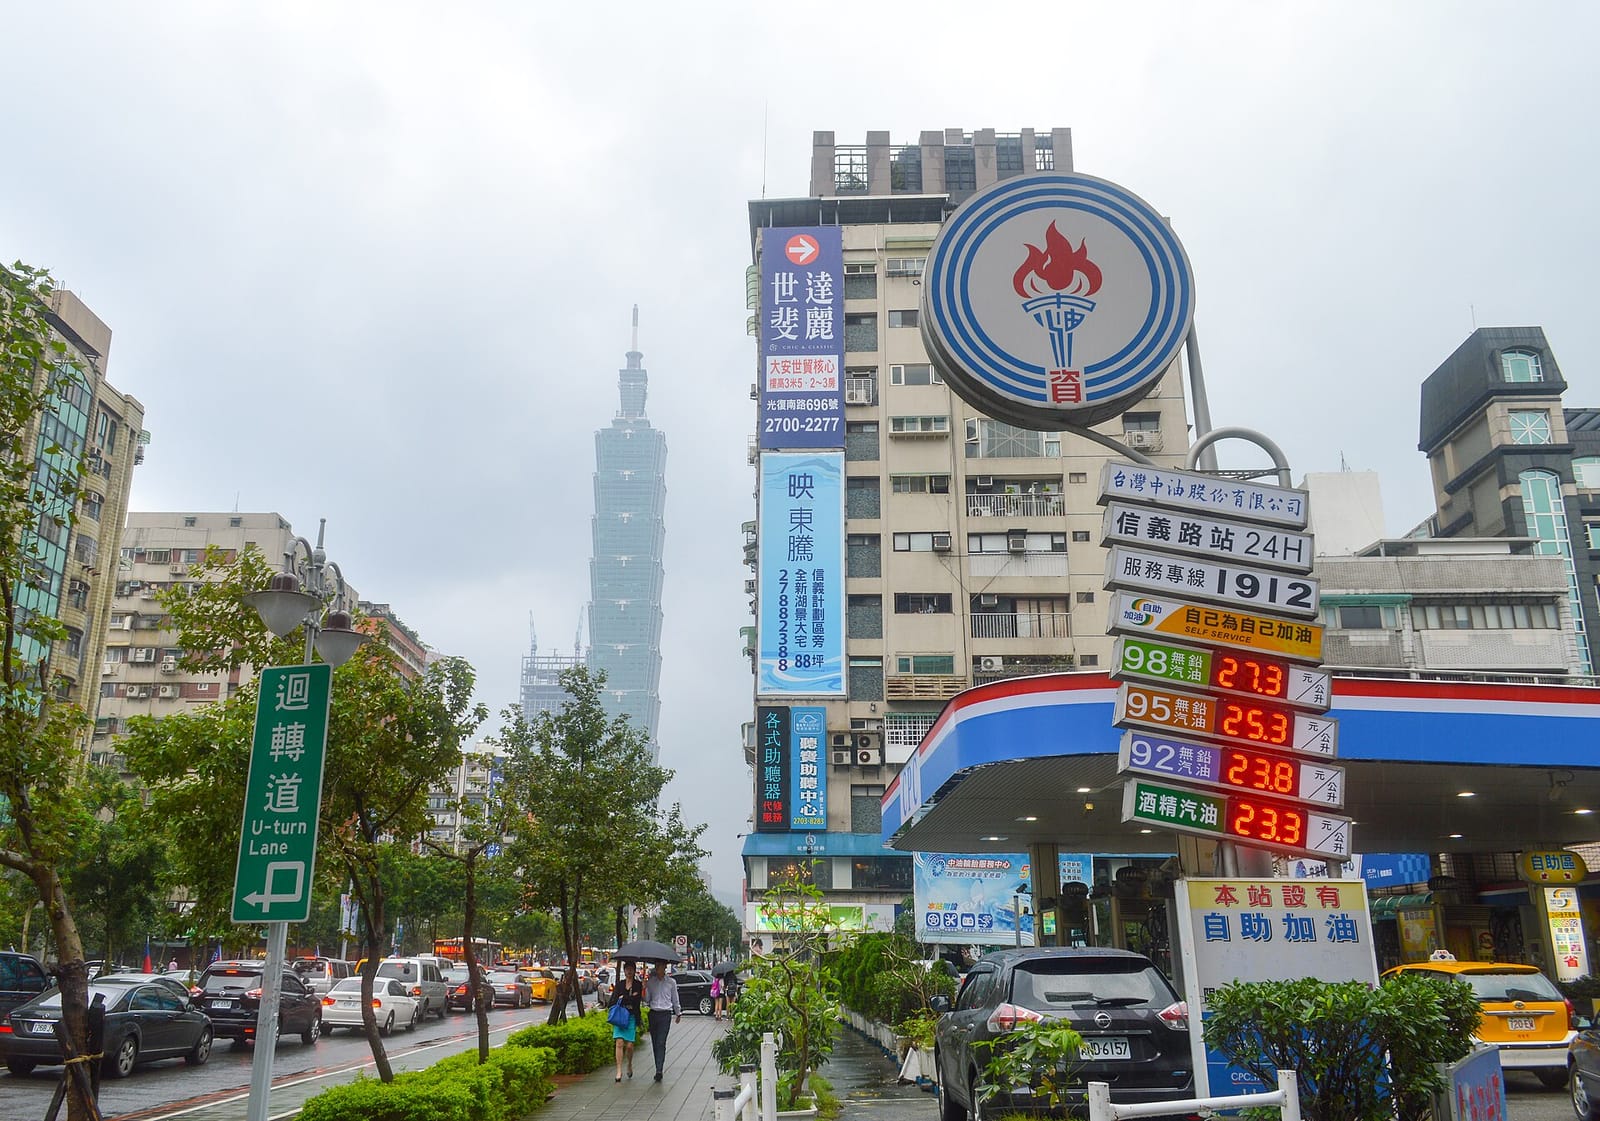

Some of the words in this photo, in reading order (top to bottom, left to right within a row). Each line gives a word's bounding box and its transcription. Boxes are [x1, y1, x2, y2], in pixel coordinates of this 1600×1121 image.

[770, 359, 835, 374] 大安世貿核心
[1050, 370, 1081, 404] 資
[766, 398, 839, 411] 光復南路696號
[765, 417, 840, 433] 2700-2277
[1113, 471, 1302, 517] 台灣中油股份有限公司
[1116, 511, 1235, 553] 信義路站
[1244, 531, 1303, 563] 24H
[1123, 557, 1206, 589] 服務專線
[1216, 569, 1312, 609] 1912
[778, 569, 789, 671] 27882388
[794, 569, 808, 648] 全新湖景大宅
[811, 568, 825, 648] 信義計劃區旁
[1124, 610, 1144, 622] 加油
[1142, 603, 1162, 615] 自助
[1185, 608, 1312, 643] 自己為自己加油
[1185, 626, 1208, 636] SELF
[1211, 629, 1252, 643] SERVICE
[1124, 645, 1167, 675] 98
[1169, 665, 1202, 682] 汽油
[1171, 651, 1203, 668] 無鉛
[1219, 657, 1282, 696] 27.3
[1127, 692, 1171, 722] 95
[1173, 712, 1206, 729] 汽油
[1175, 697, 1207, 715] 無鉛
[1223, 705, 1288, 744] 25.3
[263, 672, 311, 814] 迴轉道
[764, 712, 781, 800] 各式助聽器
[1131, 740, 1176, 771] 92
[1179, 746, 1212, 763] 無鉛
[1177, 760, 1211, 778] 汽油
[1228, 754, 1293, 793] 23.8
[1138, 790, 1218, 826] 酒精汽油
[251, 819, 307, 836] U-turn
[1234, 804, 1301, 845] 23.3
[249, 839, 289, 856] Lane
[1531, 854, 1576, 871] 自助區
[1214, 884, 1341, 908] 本站設有
[1204, 912, 1360, 943] 自助加油
